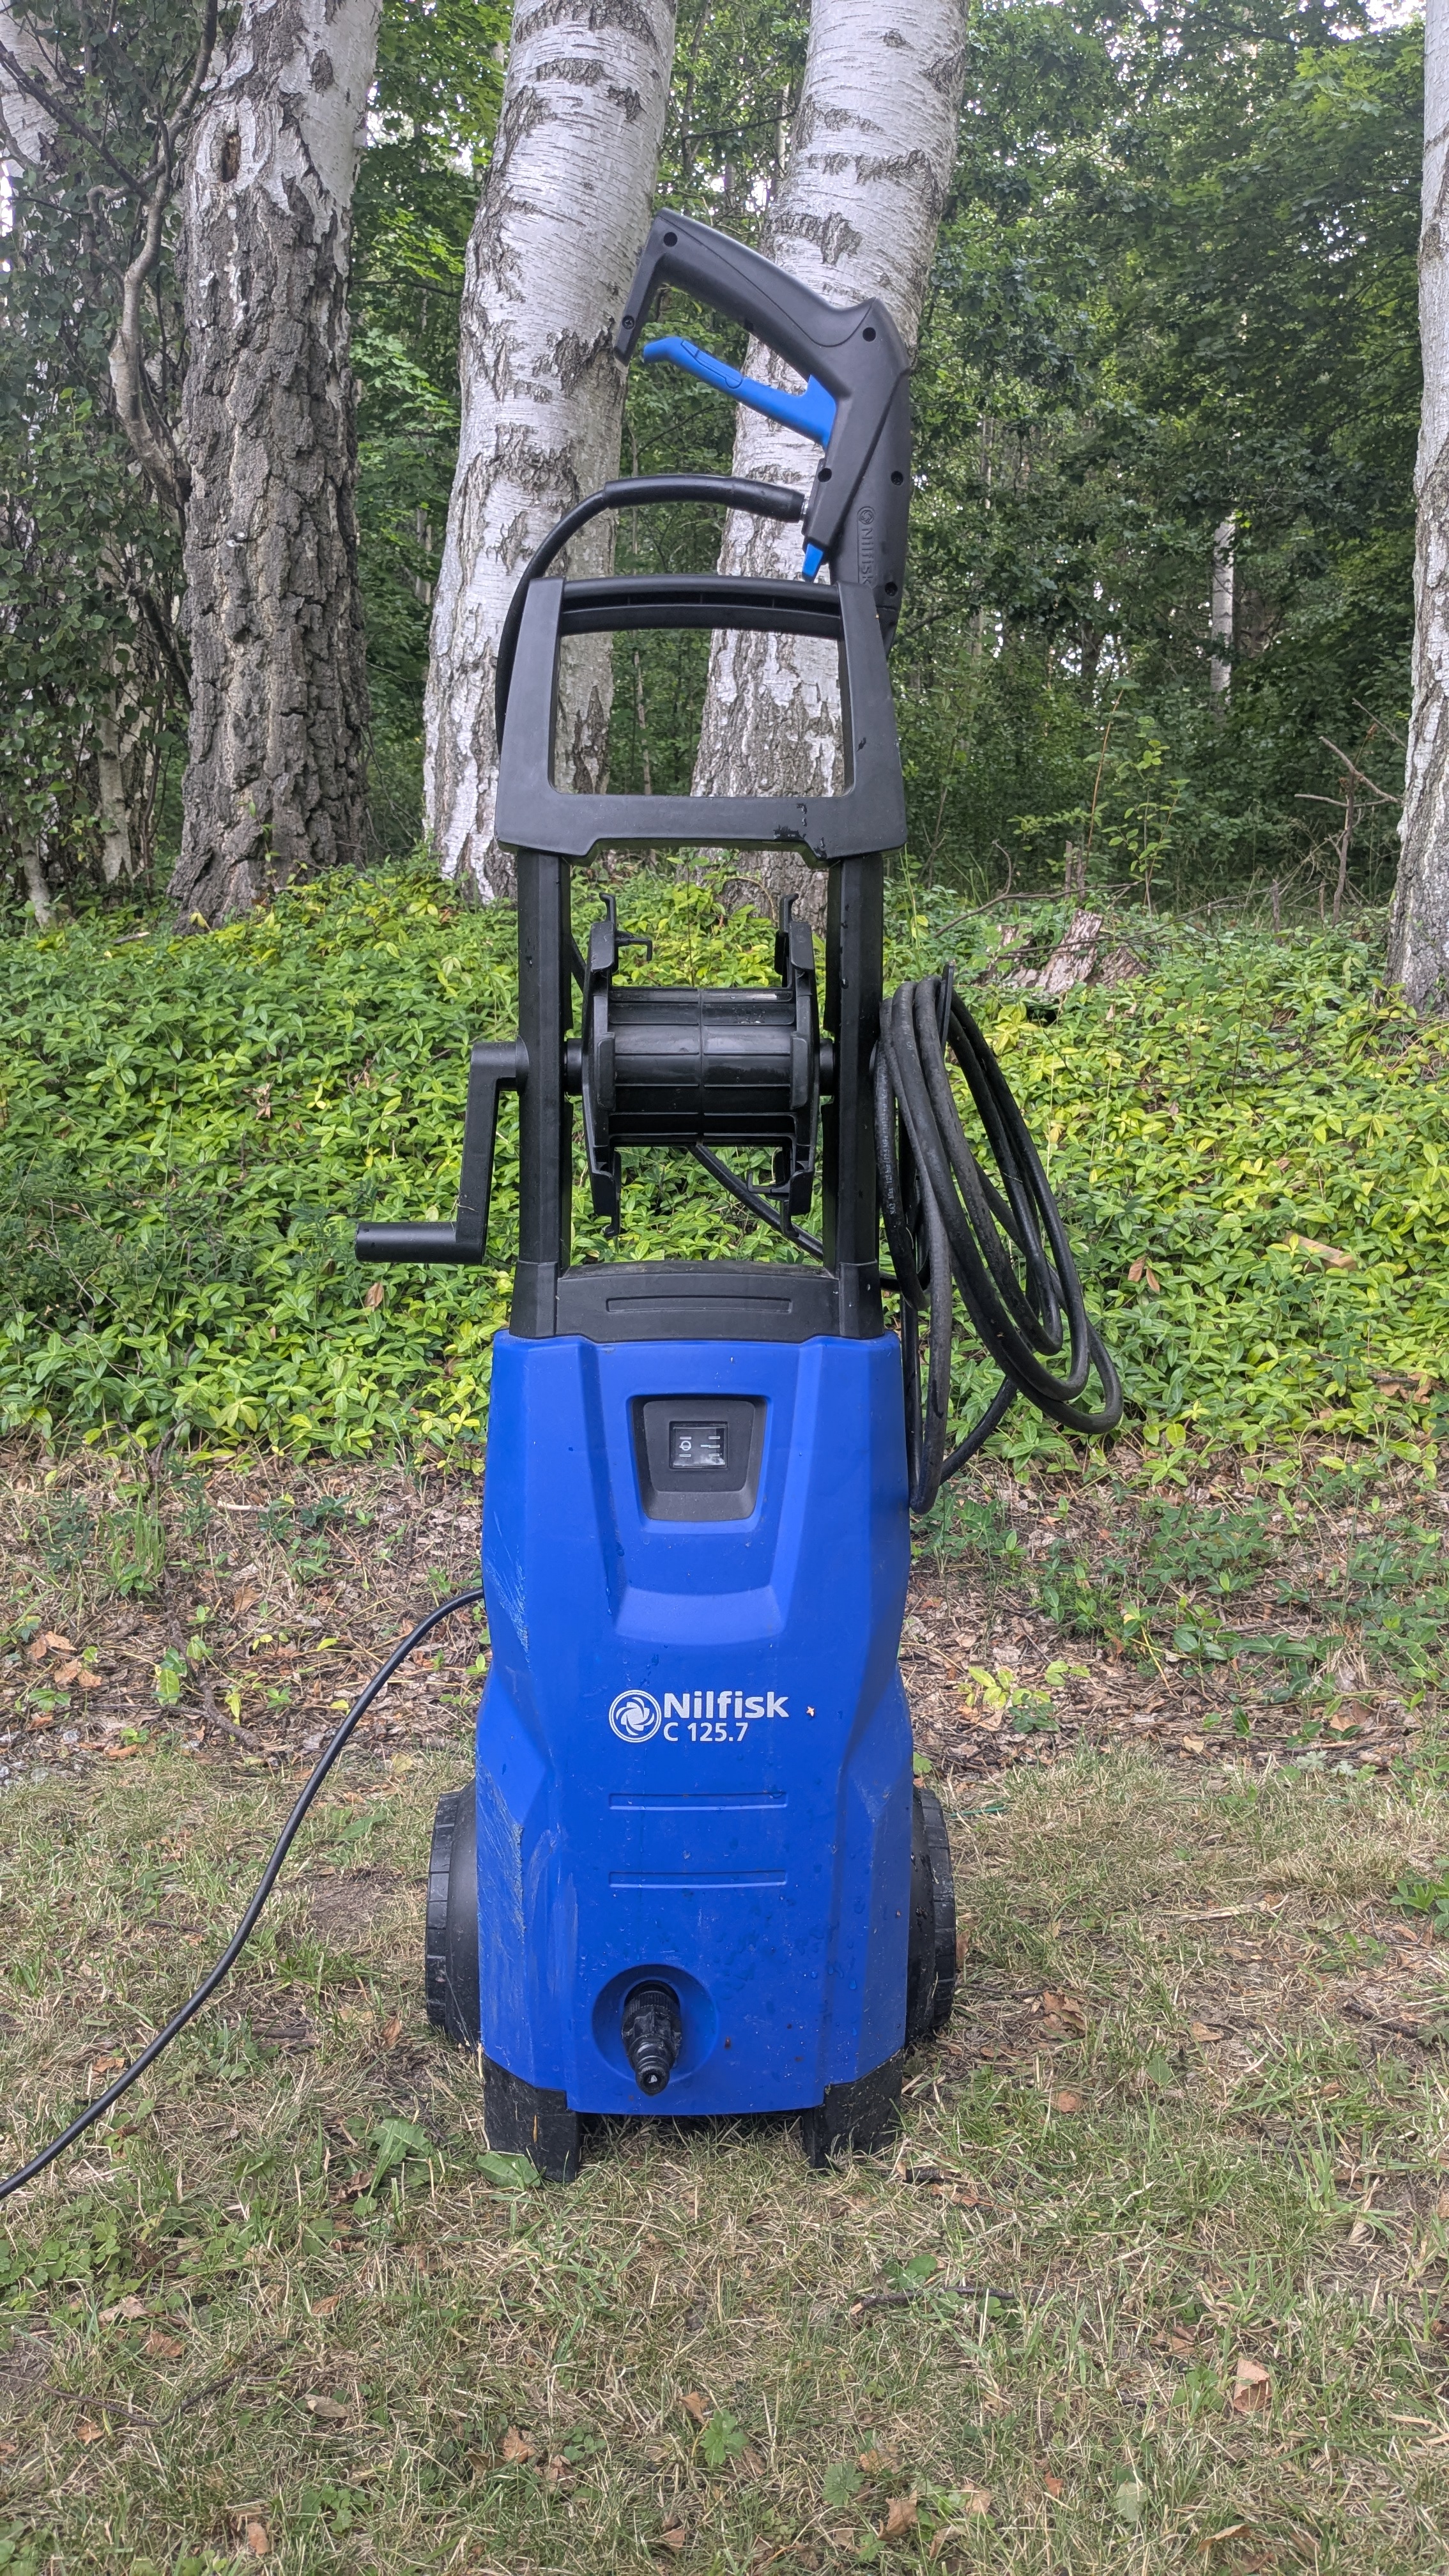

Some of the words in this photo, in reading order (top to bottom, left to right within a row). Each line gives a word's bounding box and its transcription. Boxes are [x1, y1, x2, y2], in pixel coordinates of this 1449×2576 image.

[861, 528, 874, 585] Nilfisk
[664, 1690, 790, 1719] Nilfisk
[663, 1722, 678, 1742] C
[687, 1722, 748, 1742] 125.7
